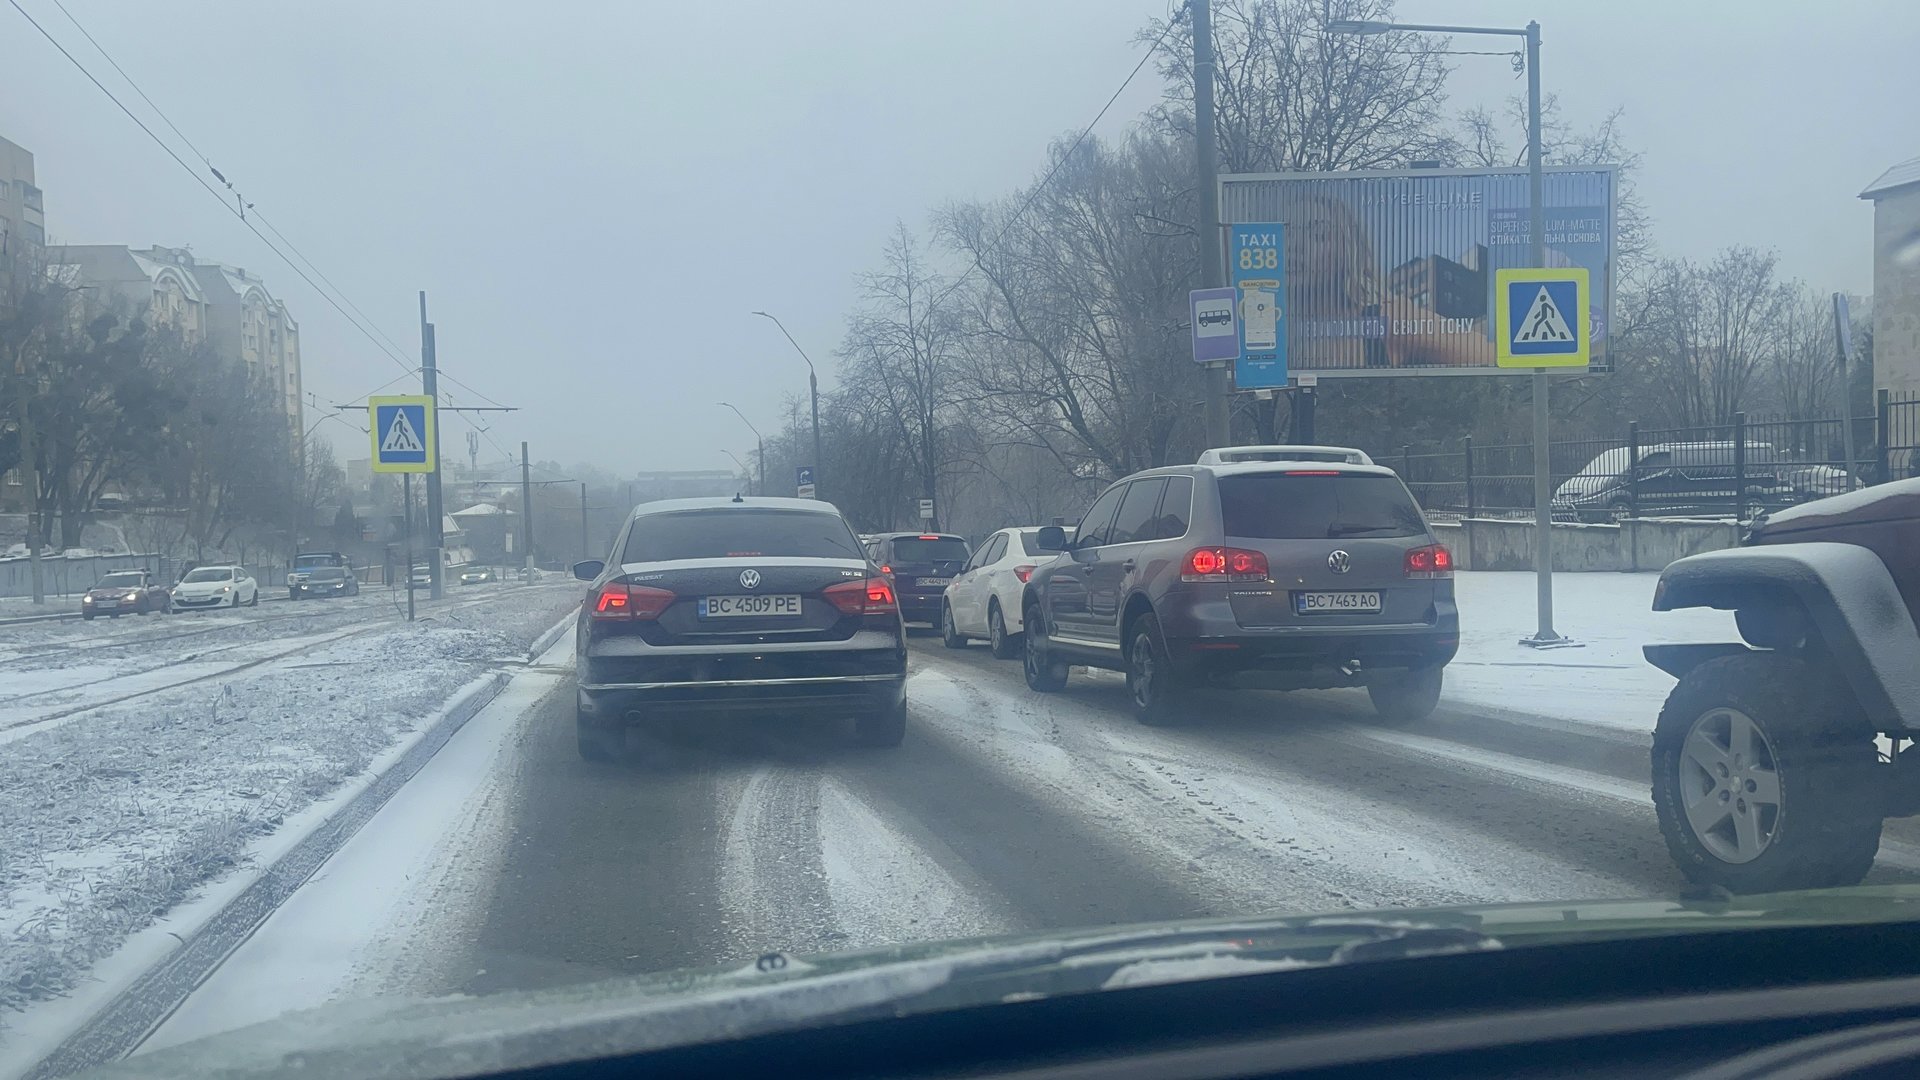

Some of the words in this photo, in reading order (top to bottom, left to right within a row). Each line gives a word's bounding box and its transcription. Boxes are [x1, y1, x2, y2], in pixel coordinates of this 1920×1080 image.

[1239, 233, 1276, 247] TAXI
[1567, 232, 1601, 243] ОСНОВА
[1239, 247, 1278, 270] 838
[1440, 317, 1475, 335] ТОНУ
[708, 599, 732, 614] BC
[735, 598, 770, 613] 4509
[775, 597, 797, 612] PE
[1307, 594, 1326, 608] BC
[1329, 594, 1358, 607] 7463
[1360, 594, 1377, 607] AO
